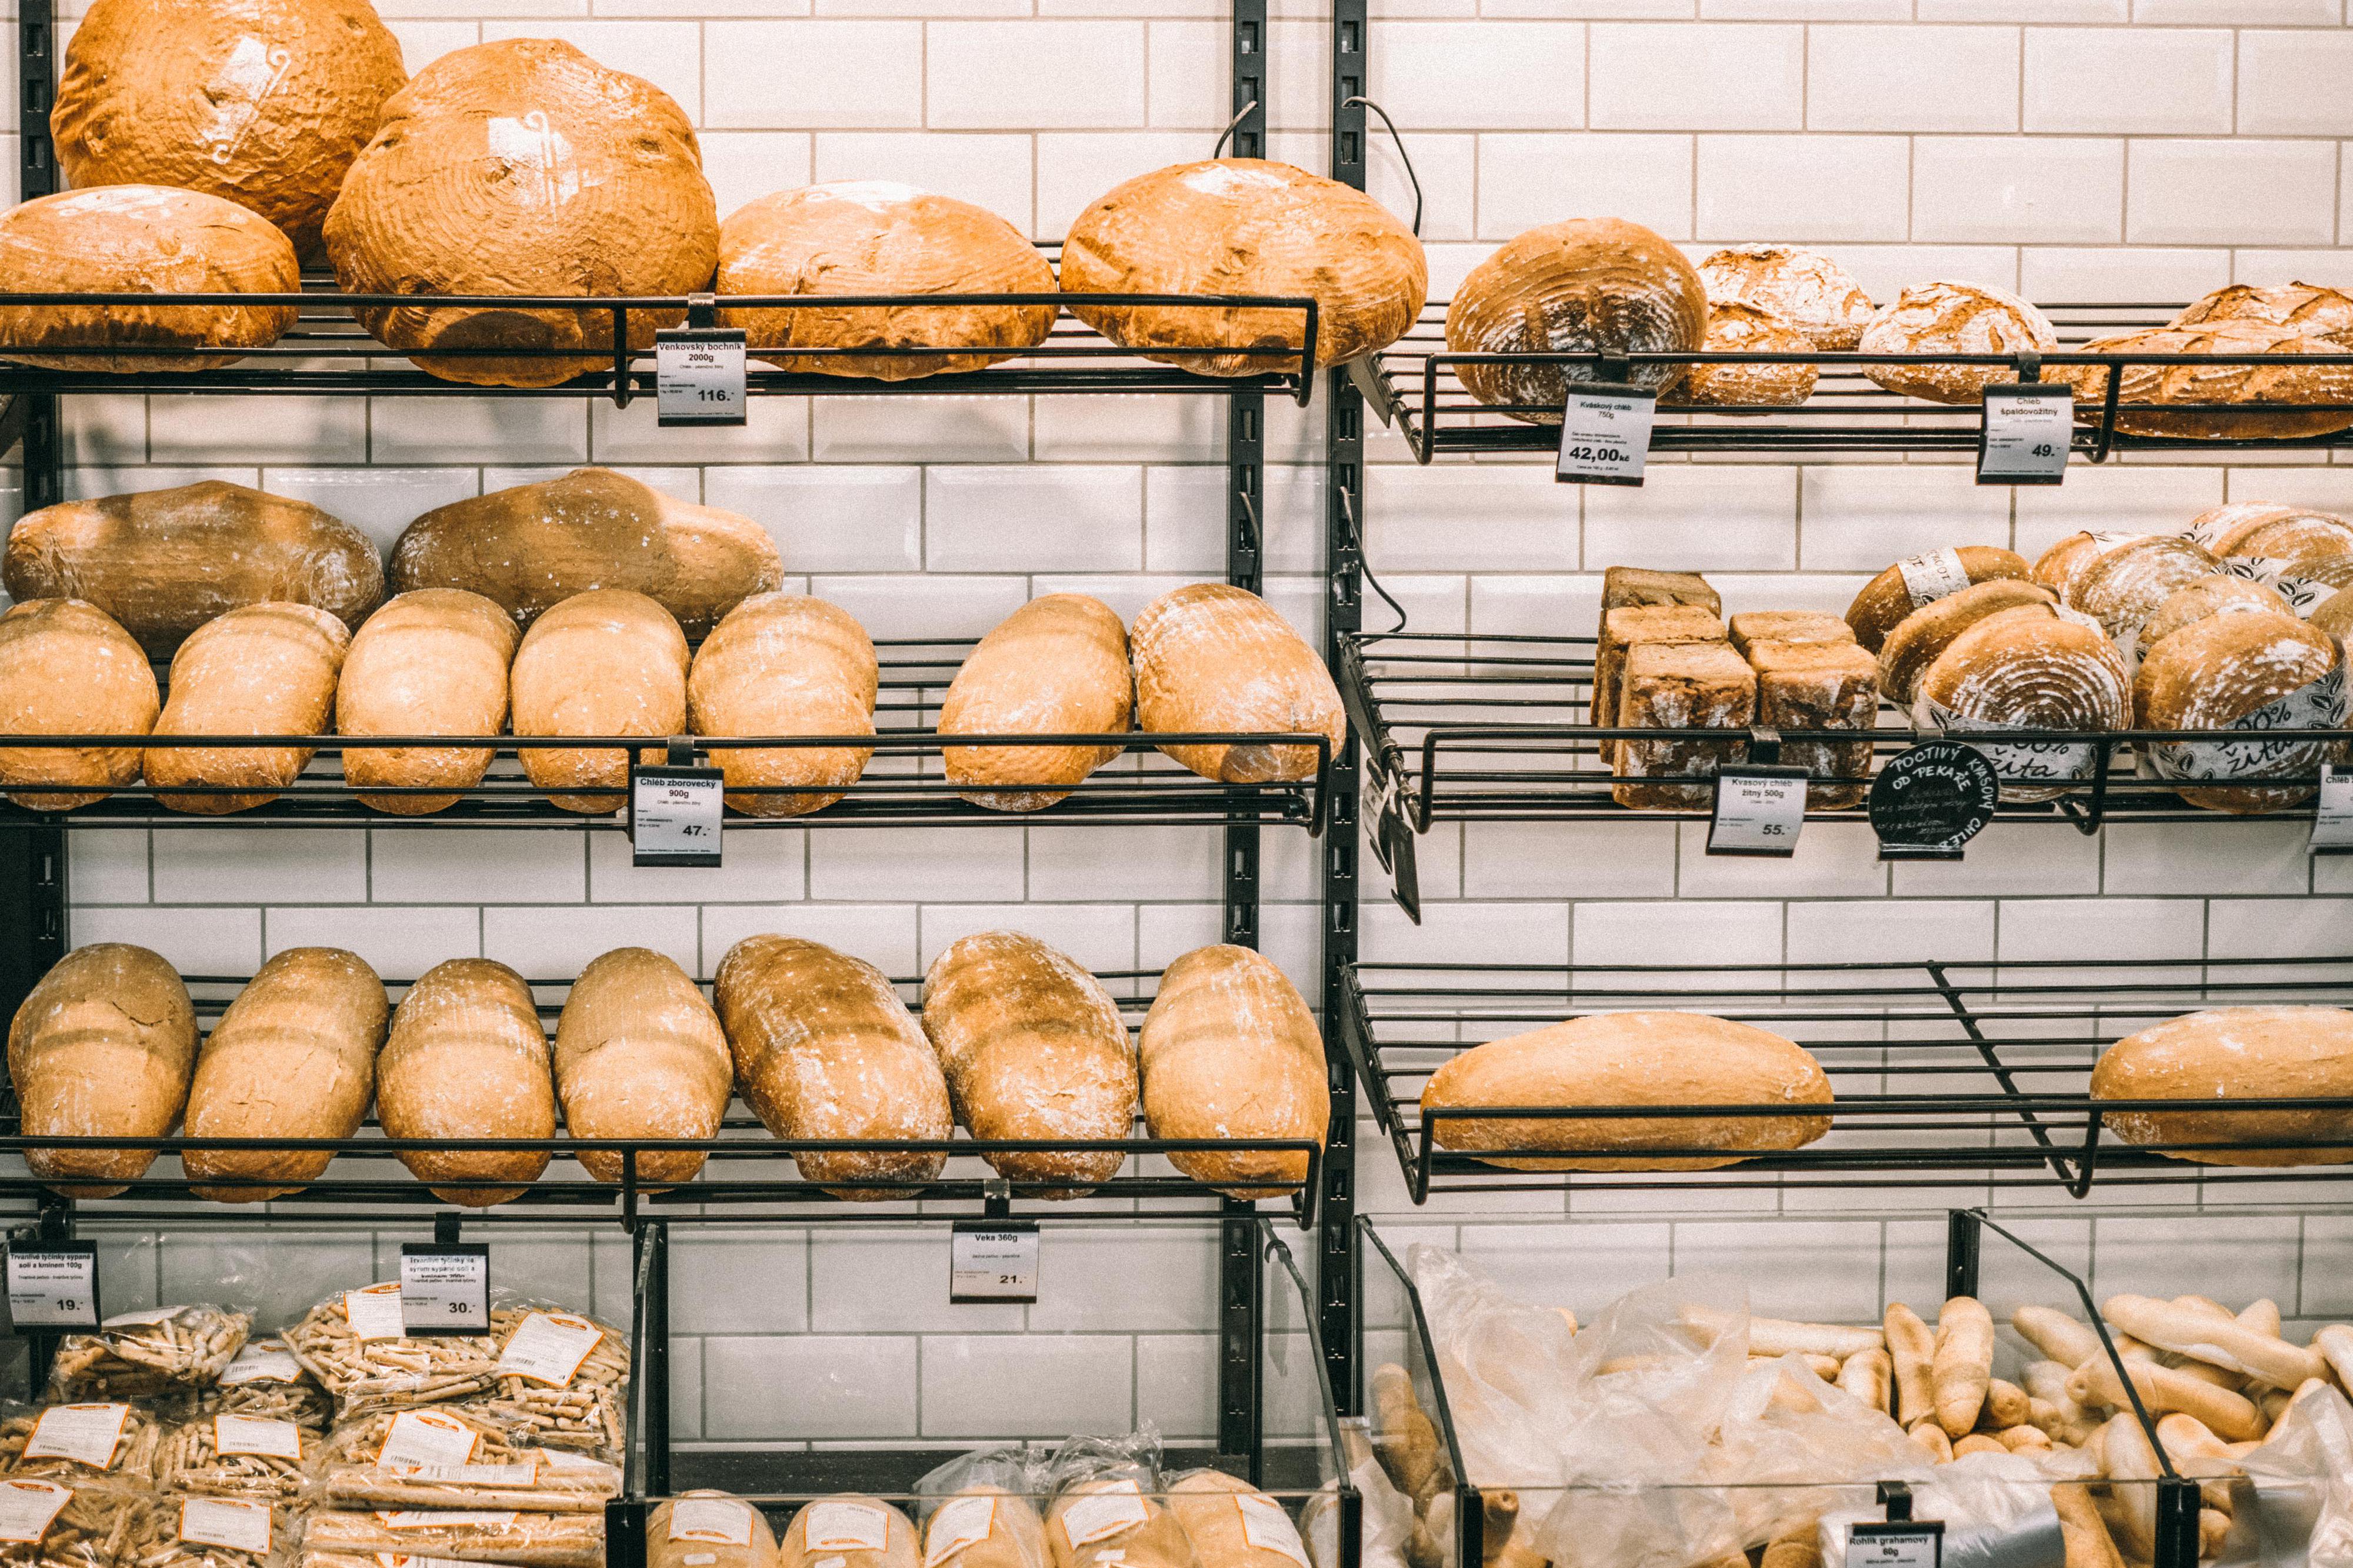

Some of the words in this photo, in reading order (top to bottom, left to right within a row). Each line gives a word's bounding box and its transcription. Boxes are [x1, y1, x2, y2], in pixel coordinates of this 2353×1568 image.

[659, 343, 705, 352] Venkovský
[689, 354, 714, 362] 2000g
[1598, 411, 1614, 419] 750g
[1889, 745, 1965, 772] POCTIVÝ
[1892, 776, 1911, 789] OD
[1912, 765, 1971, 792] PEKAŘE
[668, 779, 716, 789] zborovecký
[669, 790, 689, 798] 900g
[1765, 789, 1784, 799] 500g
[1883, 1547, 1899, 1556] 60g
